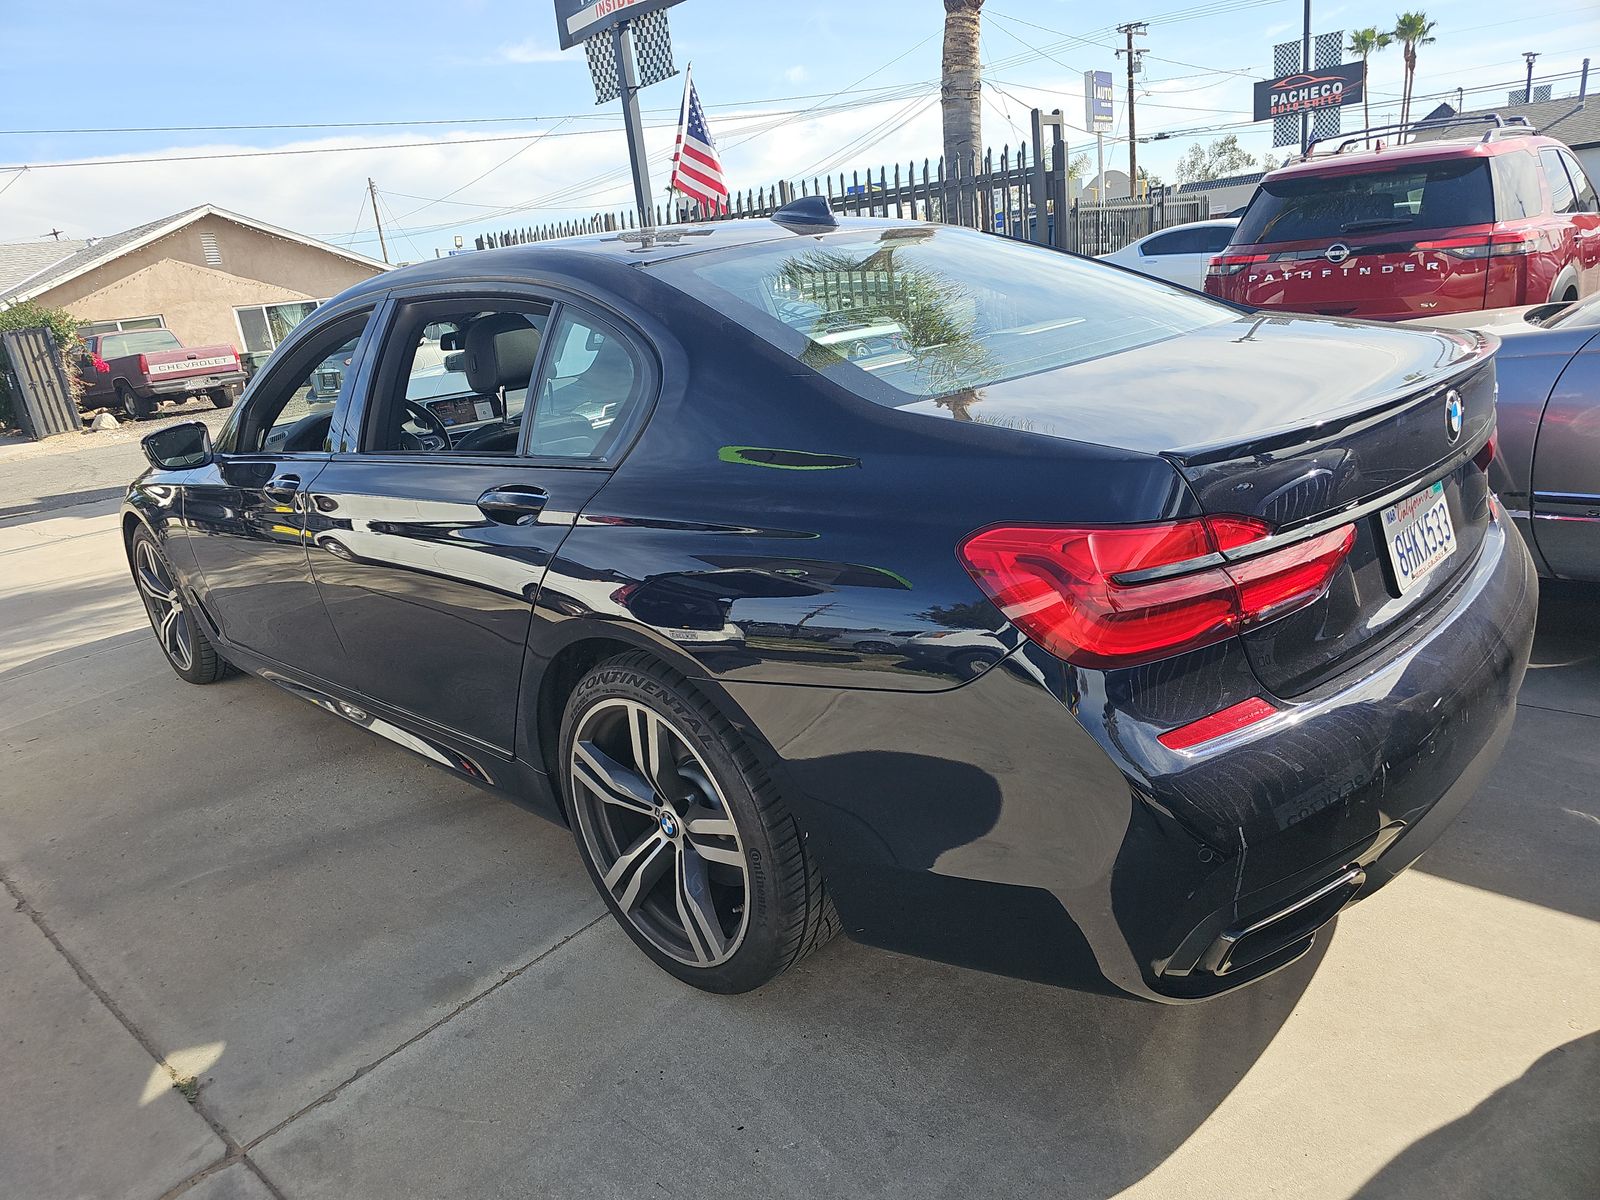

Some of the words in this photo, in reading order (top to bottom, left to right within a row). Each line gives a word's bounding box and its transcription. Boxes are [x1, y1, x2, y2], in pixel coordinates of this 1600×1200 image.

[1097, 86, 1112, 100] AUTO
[1271, 82, 1343, 106] PACHECO
[1270, 101, 1298, 115] AUTO
[1303, 95, 1343, 109] SALES
[1248, 261, 1439, 282] PATHFINDER
[158, 357, 228, 372] CHEVROLET
[1396, 490, 1434, 522] California
[1395, 502, 1451, 577] 8HKX533
[577, 670, 714, 750] CONTINENTAL
